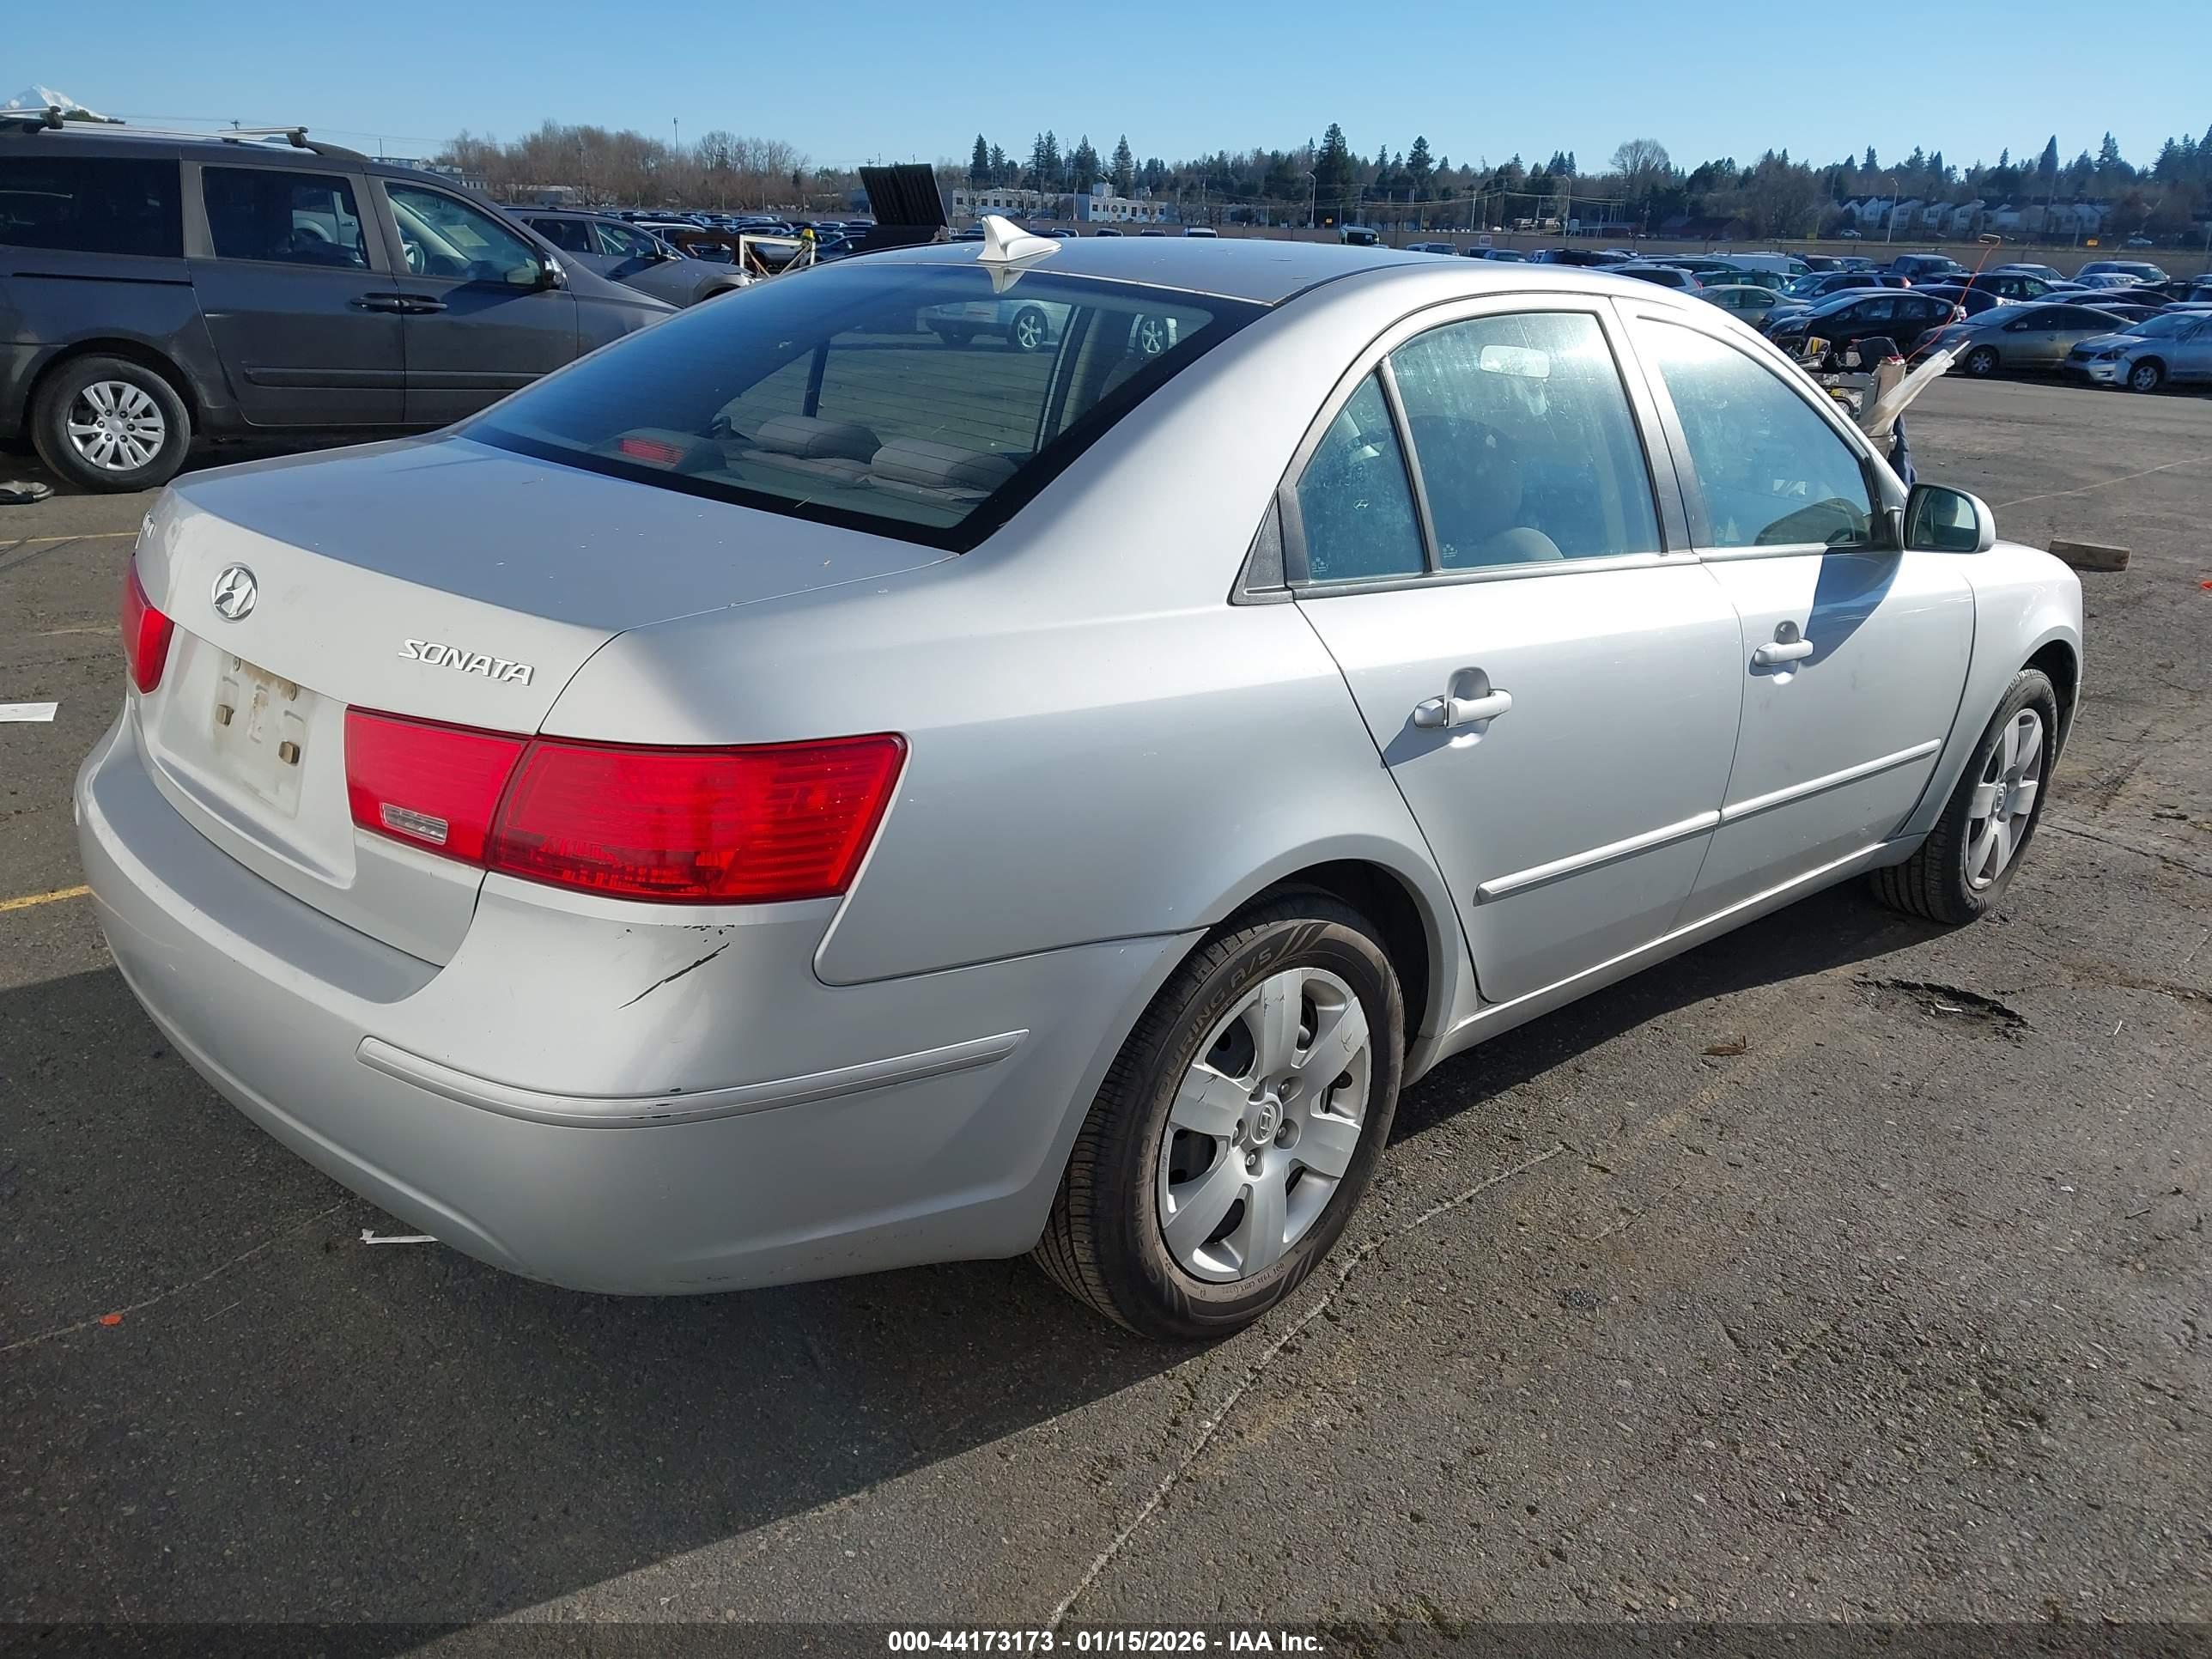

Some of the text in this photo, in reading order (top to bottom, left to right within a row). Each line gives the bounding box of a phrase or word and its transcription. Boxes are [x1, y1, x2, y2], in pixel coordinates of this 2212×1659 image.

[398, 638, 535, 686] SONATA
[1147, 988, 1226, 1122] TOURING
[1229, 946, 1272, 990] A/S
